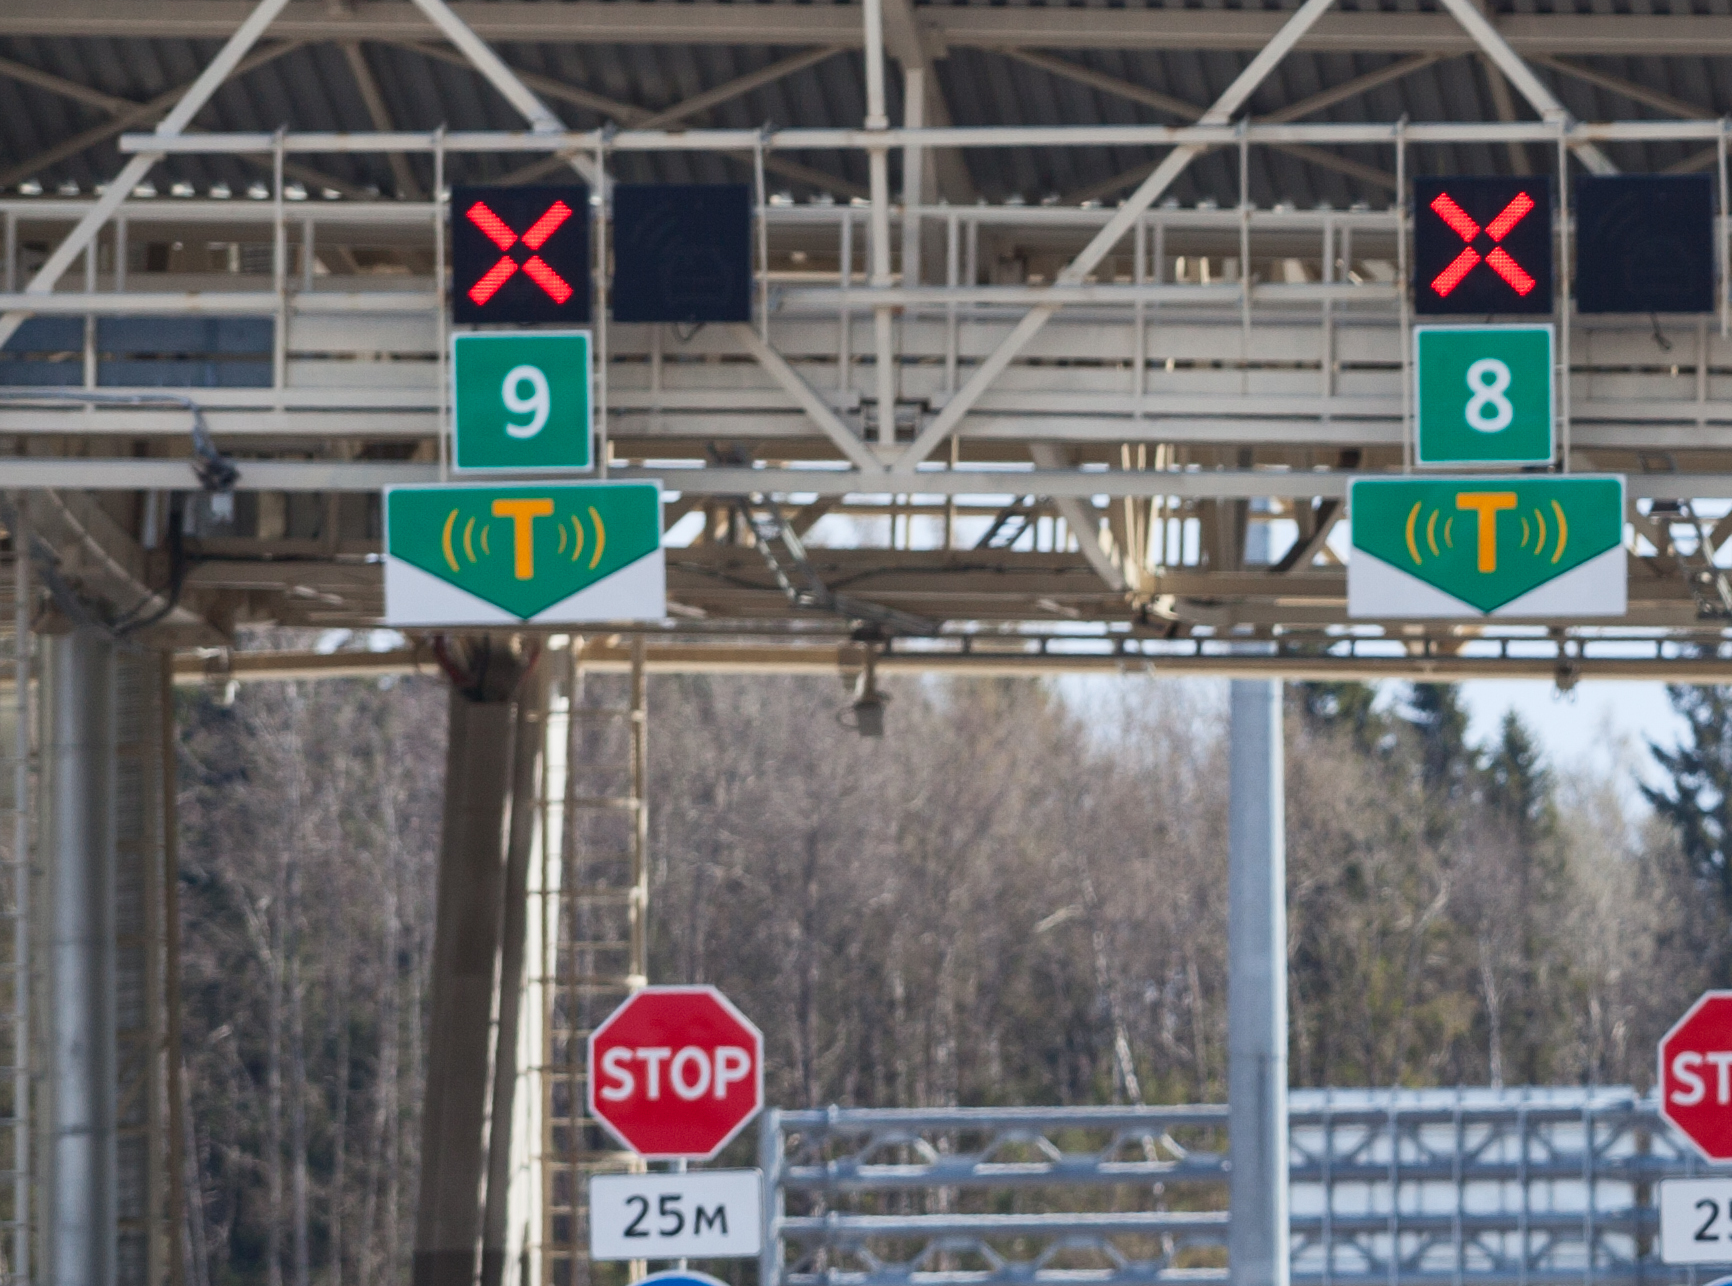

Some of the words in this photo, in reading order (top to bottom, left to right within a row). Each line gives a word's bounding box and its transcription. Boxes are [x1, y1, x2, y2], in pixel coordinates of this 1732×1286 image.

[502, 366, 550, 438] 9
[1466, 359, 1512, 432] 8
[600, 1045, 752, 1102] STOP
